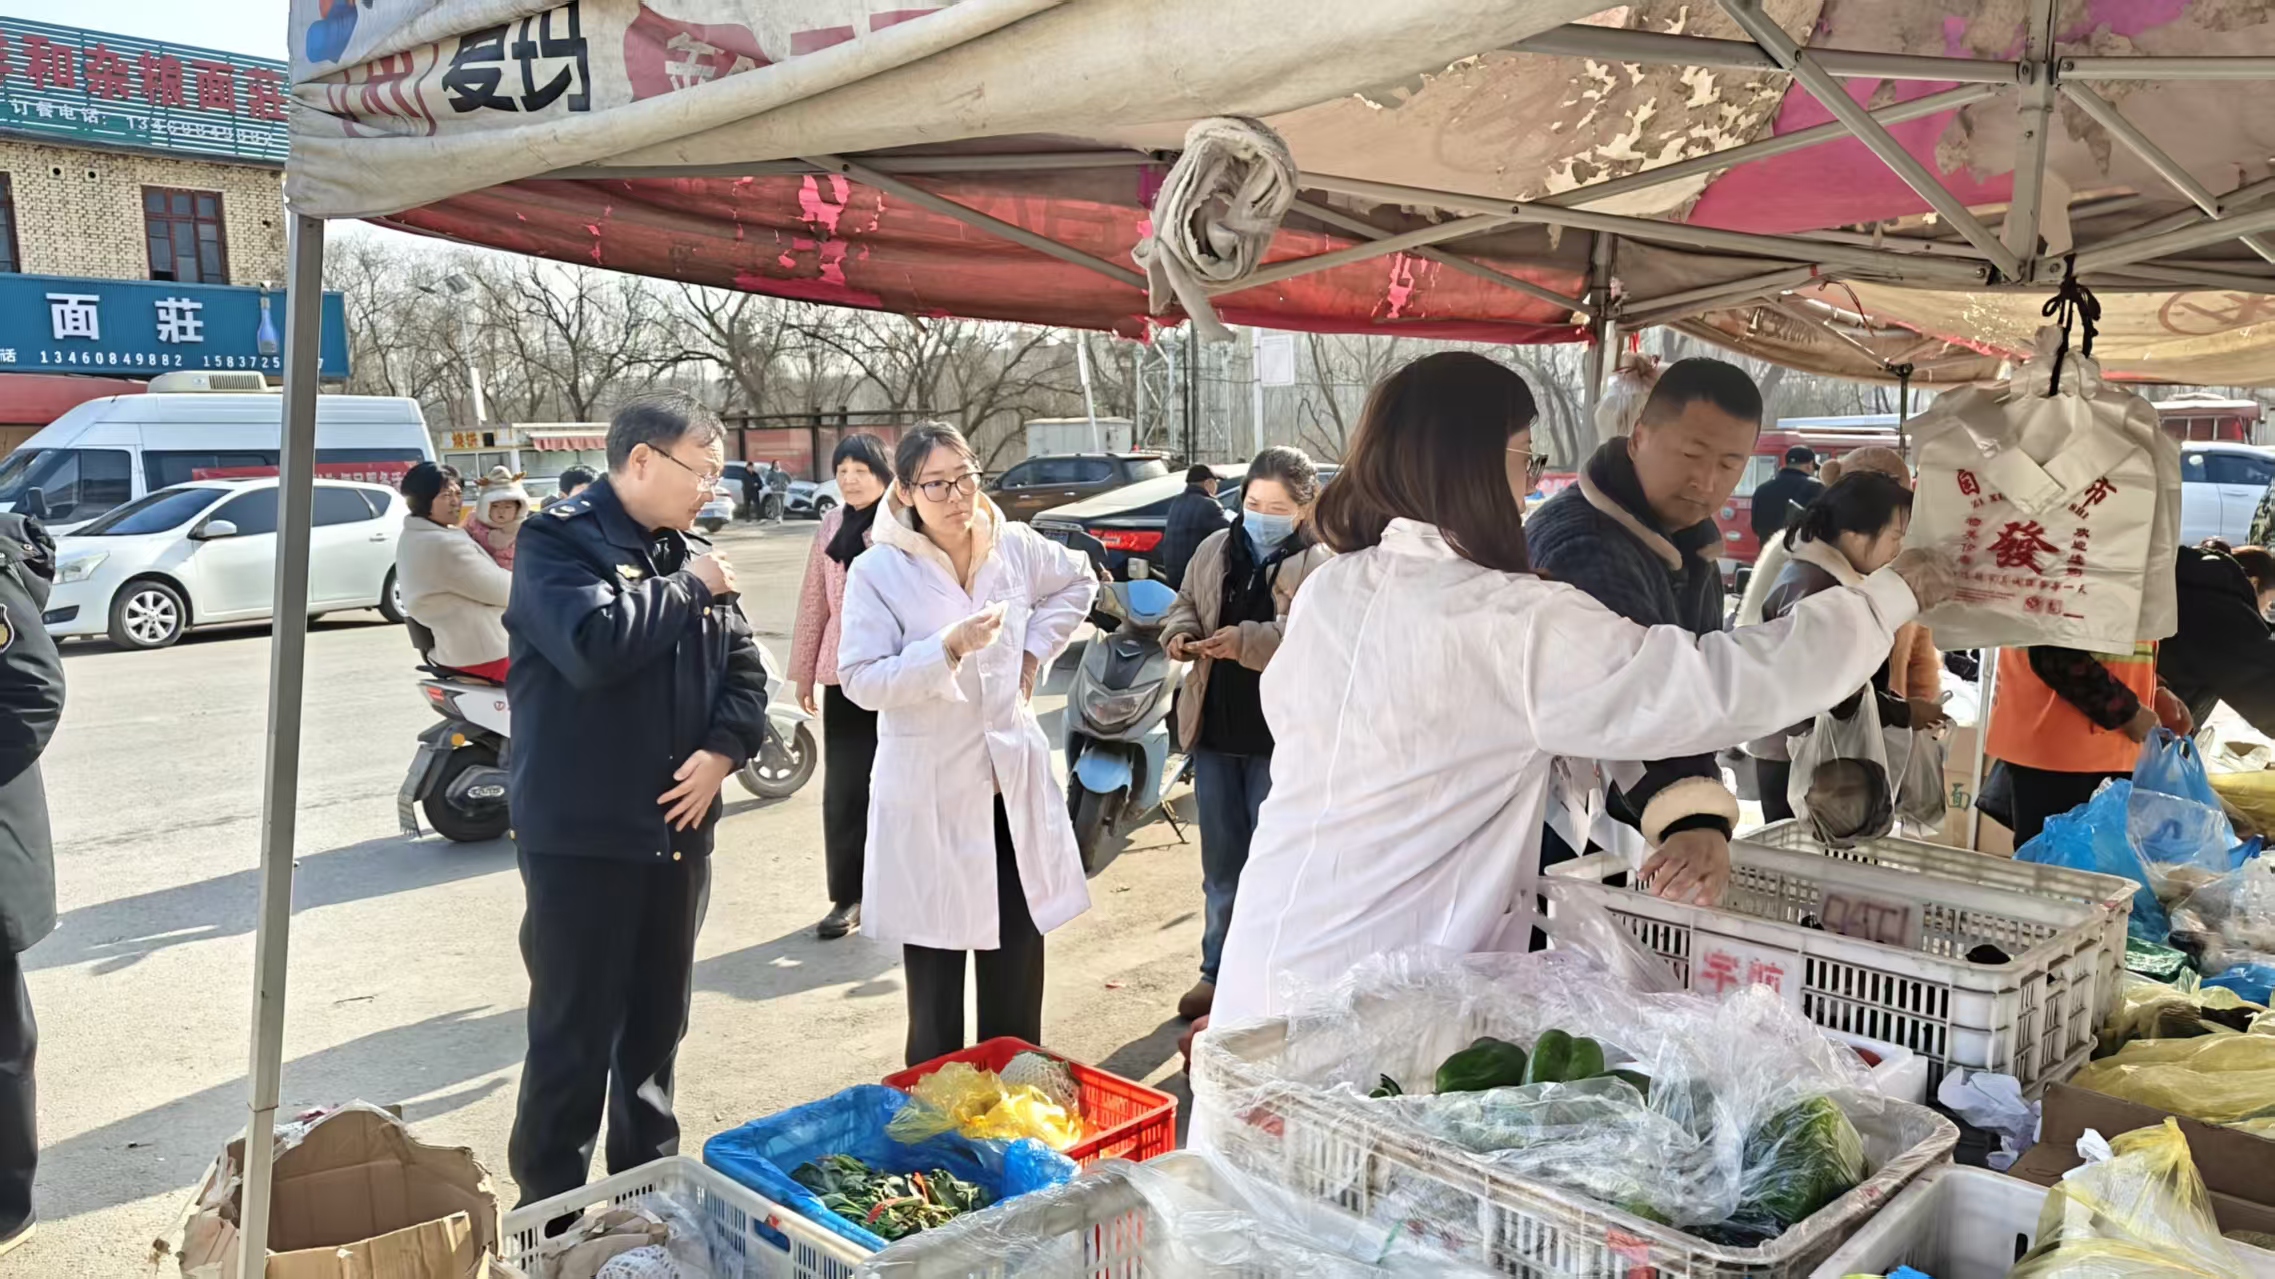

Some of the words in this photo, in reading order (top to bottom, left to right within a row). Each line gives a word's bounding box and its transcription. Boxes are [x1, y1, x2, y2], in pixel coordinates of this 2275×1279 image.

[0, 30, 289, 120] 和杂粮面莊
[40, 350, 183, 368] 13460849882
[1986, 519, 2060, 577] 發
